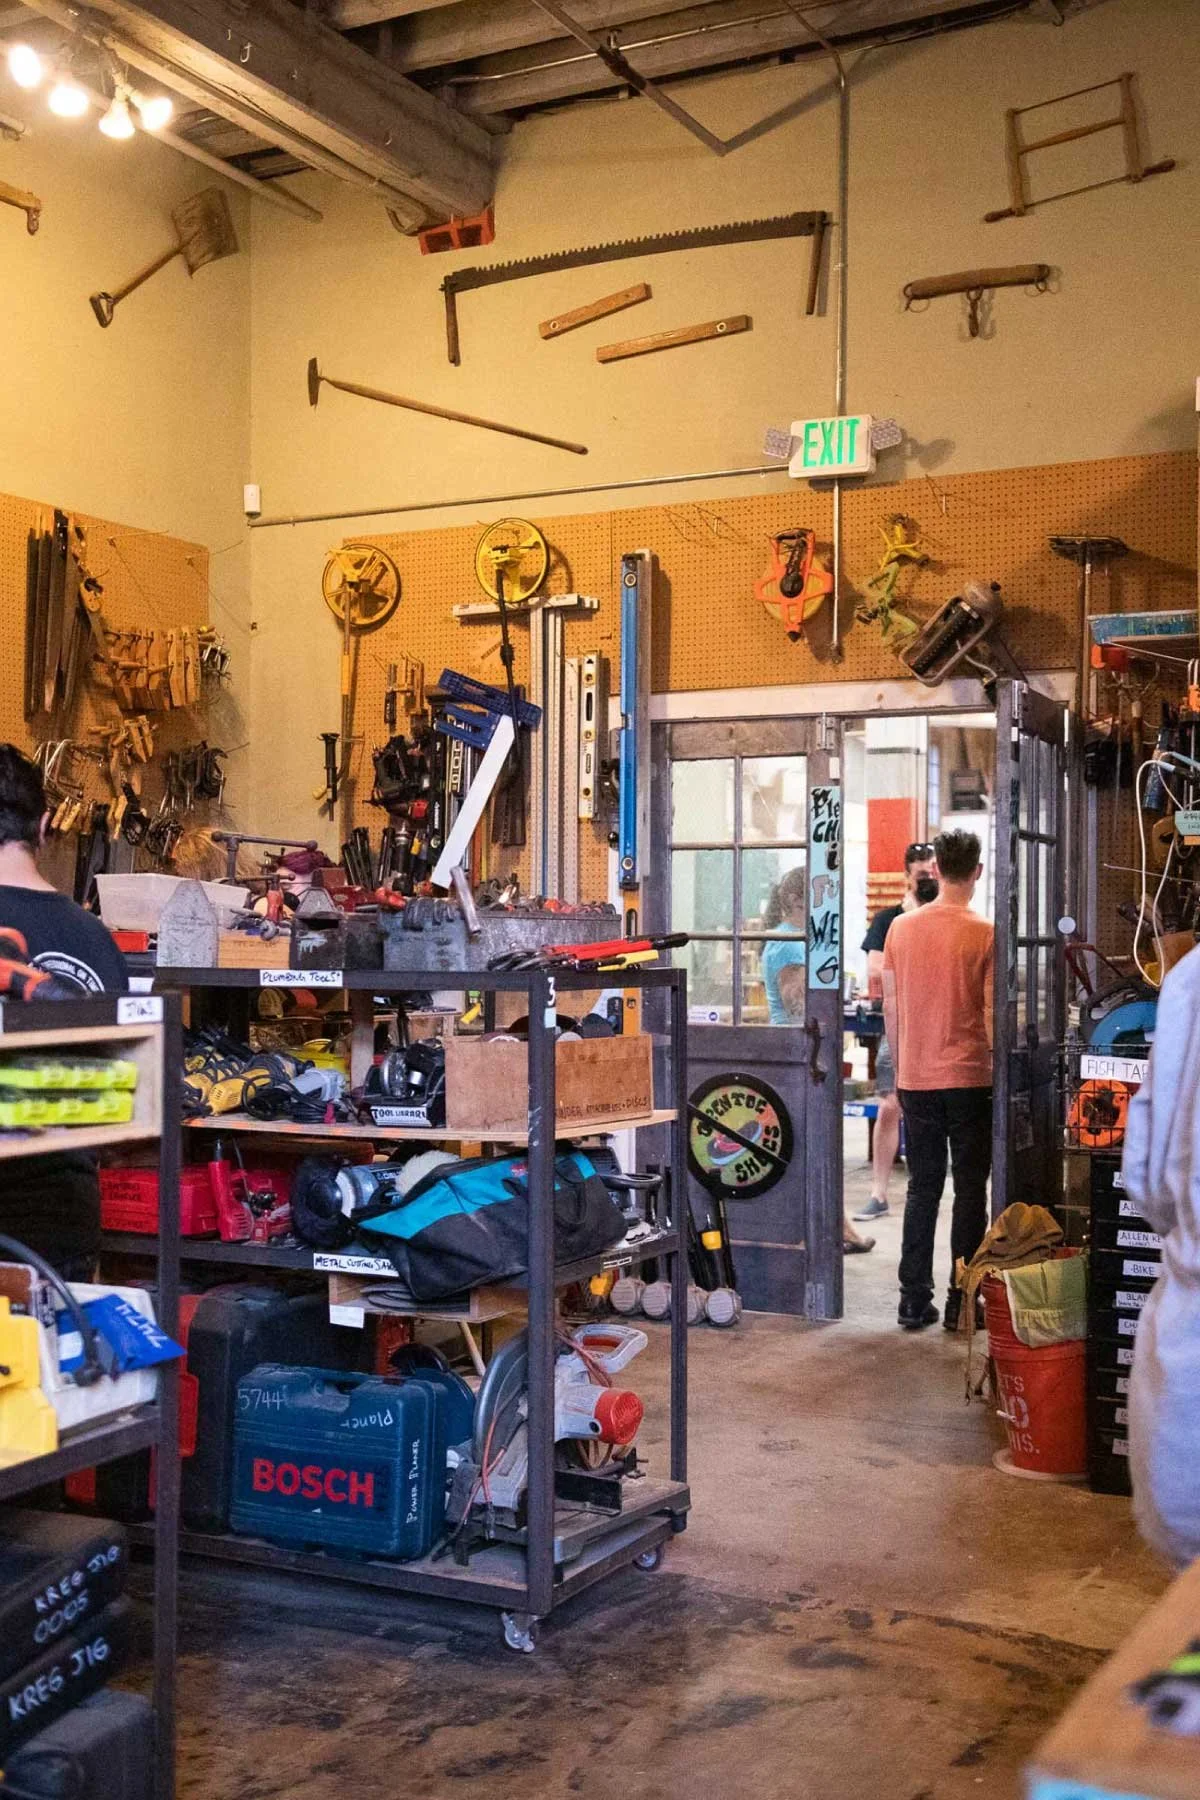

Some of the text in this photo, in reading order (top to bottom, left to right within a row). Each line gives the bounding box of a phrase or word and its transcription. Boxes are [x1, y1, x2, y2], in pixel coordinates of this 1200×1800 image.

[803, 418, 860, 467] EXIT
[813, 820, 840, 843] CH
[262, 971, 306, 983] PLUMBING
[1087, 1059, 1150, 1080] FISH TAP
[370, 1108, 394, 1119] TOOL
[1120, 1232, 1148, 1241] ALLEN
[315, 1256, 396, 1271] METAL CUTTING SAW
[1132, 1264, 1156, 1276] BIKE
[237, 1388, 281, 1411] 5744
[340, 1409, 394, 1429] Planer
[253, 1457, 375, 1508] BOSCH
[8, 1637, 110, 1720] KREG JIG
